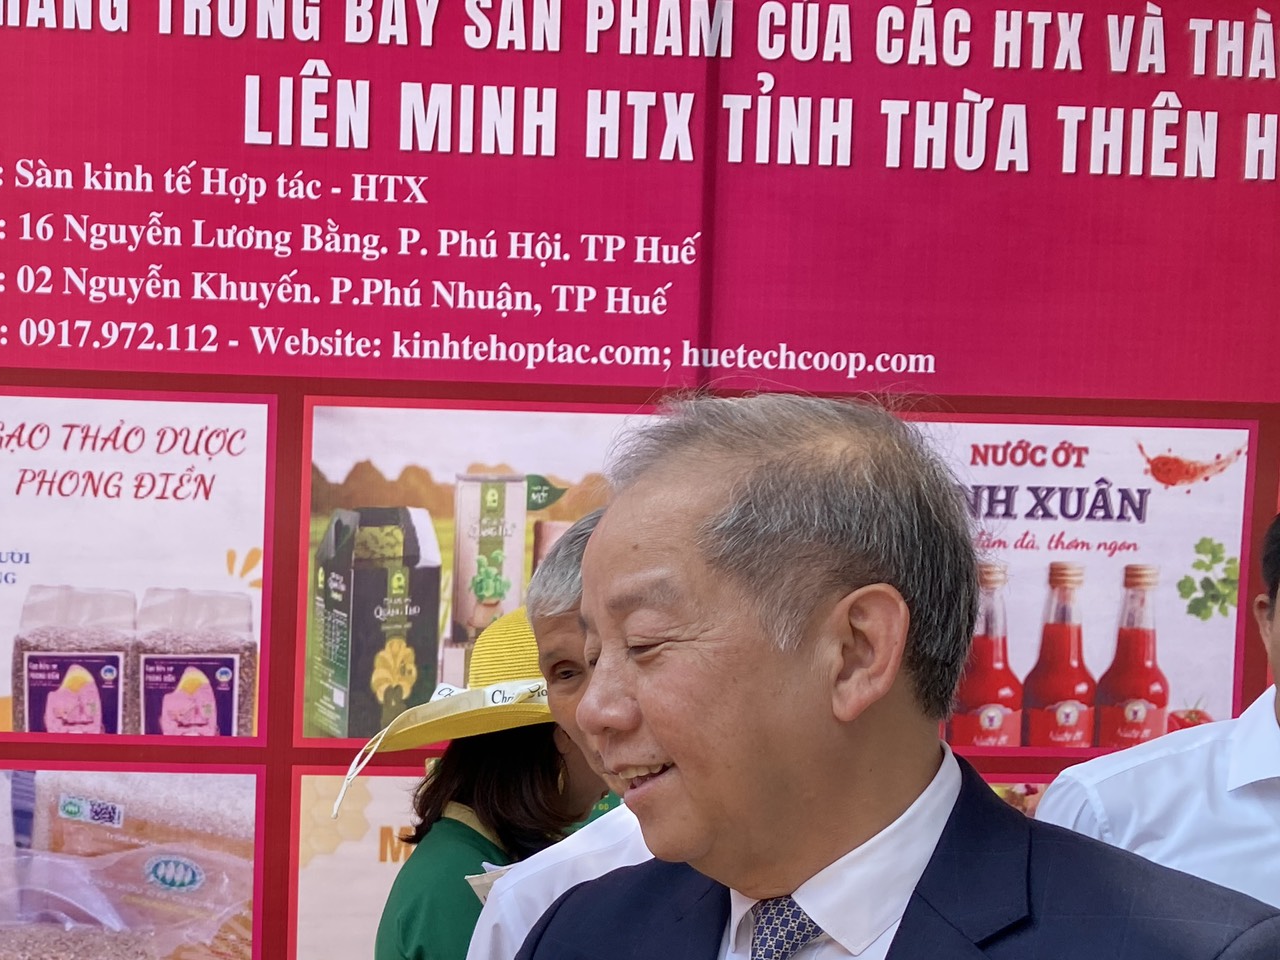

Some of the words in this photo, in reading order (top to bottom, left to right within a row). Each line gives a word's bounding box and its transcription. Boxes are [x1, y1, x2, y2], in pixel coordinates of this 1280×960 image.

[993, 10, 1084, 71] HTX
[1107, 1, 1166, 74] VÀ
[244, 58, 370, 149] LIÊN
[400, 81, 558, 158] MINH
[585, 89, 695, 162] HTX
[722, 72, 853, 167] TỈNH
[880, 87, 1030, 173] THỪA
[1057, 91, 1219, 179] THIÊN
[15, 158, 74, 190] Sàn
[84, 161, 154, 193] kinh
[164, 160, 197, 194] tế
[201, 167, 267, 205] Hợp
[277, 170, 322, 200] tác
[351, 173, 429, 204] HTX
[19, 212, 54, 242] 16
[63, 211, 183, 252] Nguyễn
[191, 219, 293, 258] Lương
[301, 218, 389, 261] Bằng.
[397, 227, 429, 257] P.
[437, 228, 498, 260] Phú
[507, 230, 571, 268] Hội.
[580, 233, 626, 263] TP
[634, 231, 701, 266] Huế
[17, 264, 53, 295] 02
[62, 263, 182, 305] Nguyễn
[191, 269, 321, 309] Khuyến.
[330, 276, 423, 308] P.Phú
[431, 279, 543, 318] Nhuận,
[551, 283, 597, 314] TP
[604, 281, 673, 316] Huế
[19, 317, 219, 353] 0917.972.112
[249, 325, 382, 359] Website:
[391, 330, 672, 372] kinhtehoptac.com;
[681, 340, 937, 380] huetechcoop.com
[61, 419, 146, 455] THẢO
[155, 425, 248, 462] DƯỢC
[970, 439, 1048, 468] NƯỚC
[1052, 440, 1090, 468] ỚT
[15, 467, 124, 500] PHONG
[1024, 476, 1152, 524] XUÂN
